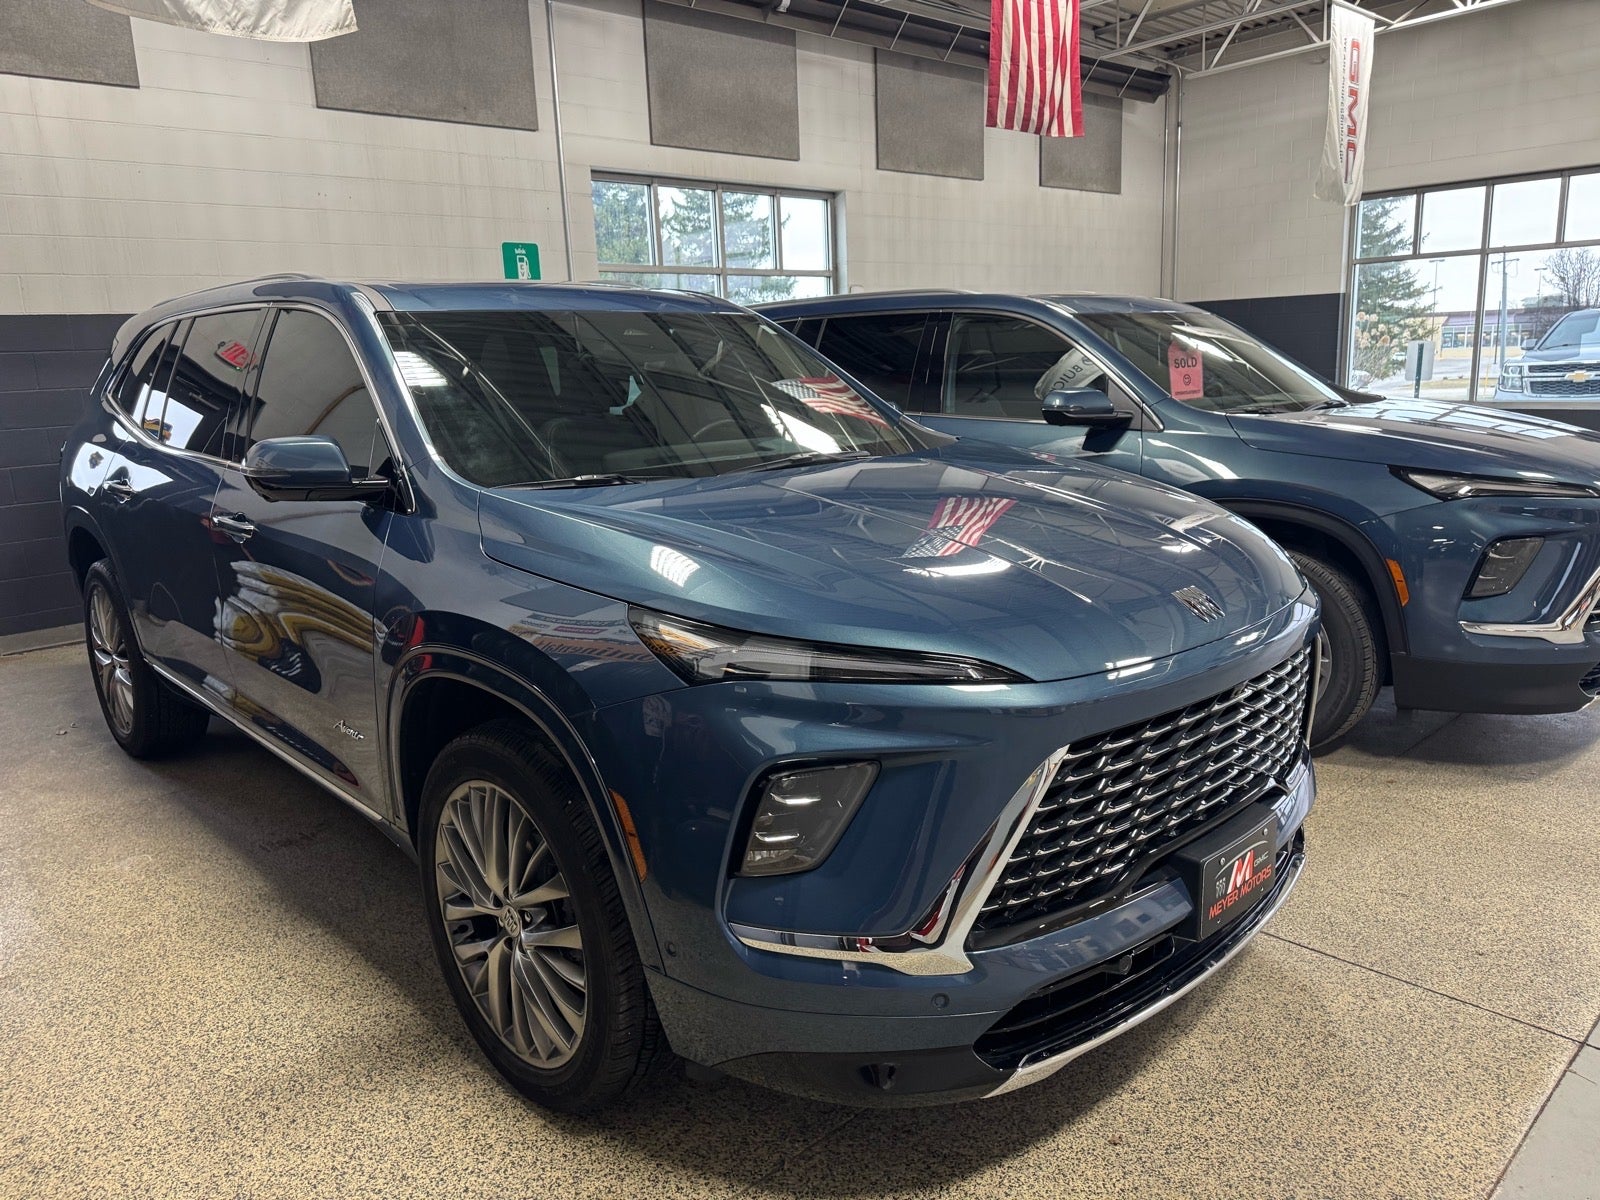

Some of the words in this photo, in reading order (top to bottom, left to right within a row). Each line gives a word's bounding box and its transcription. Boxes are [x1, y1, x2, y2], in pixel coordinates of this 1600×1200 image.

[1344, 38, 1360, 184] GMC
[1174, 356, 1198, 369] SOLD
[333, 719, 364, 740] Avenir
[1253, 851, 1269, 867] GMC
[1208, 889, 1240, 920] MEYER
[1240, 863, 1272, 898] MOTORS
